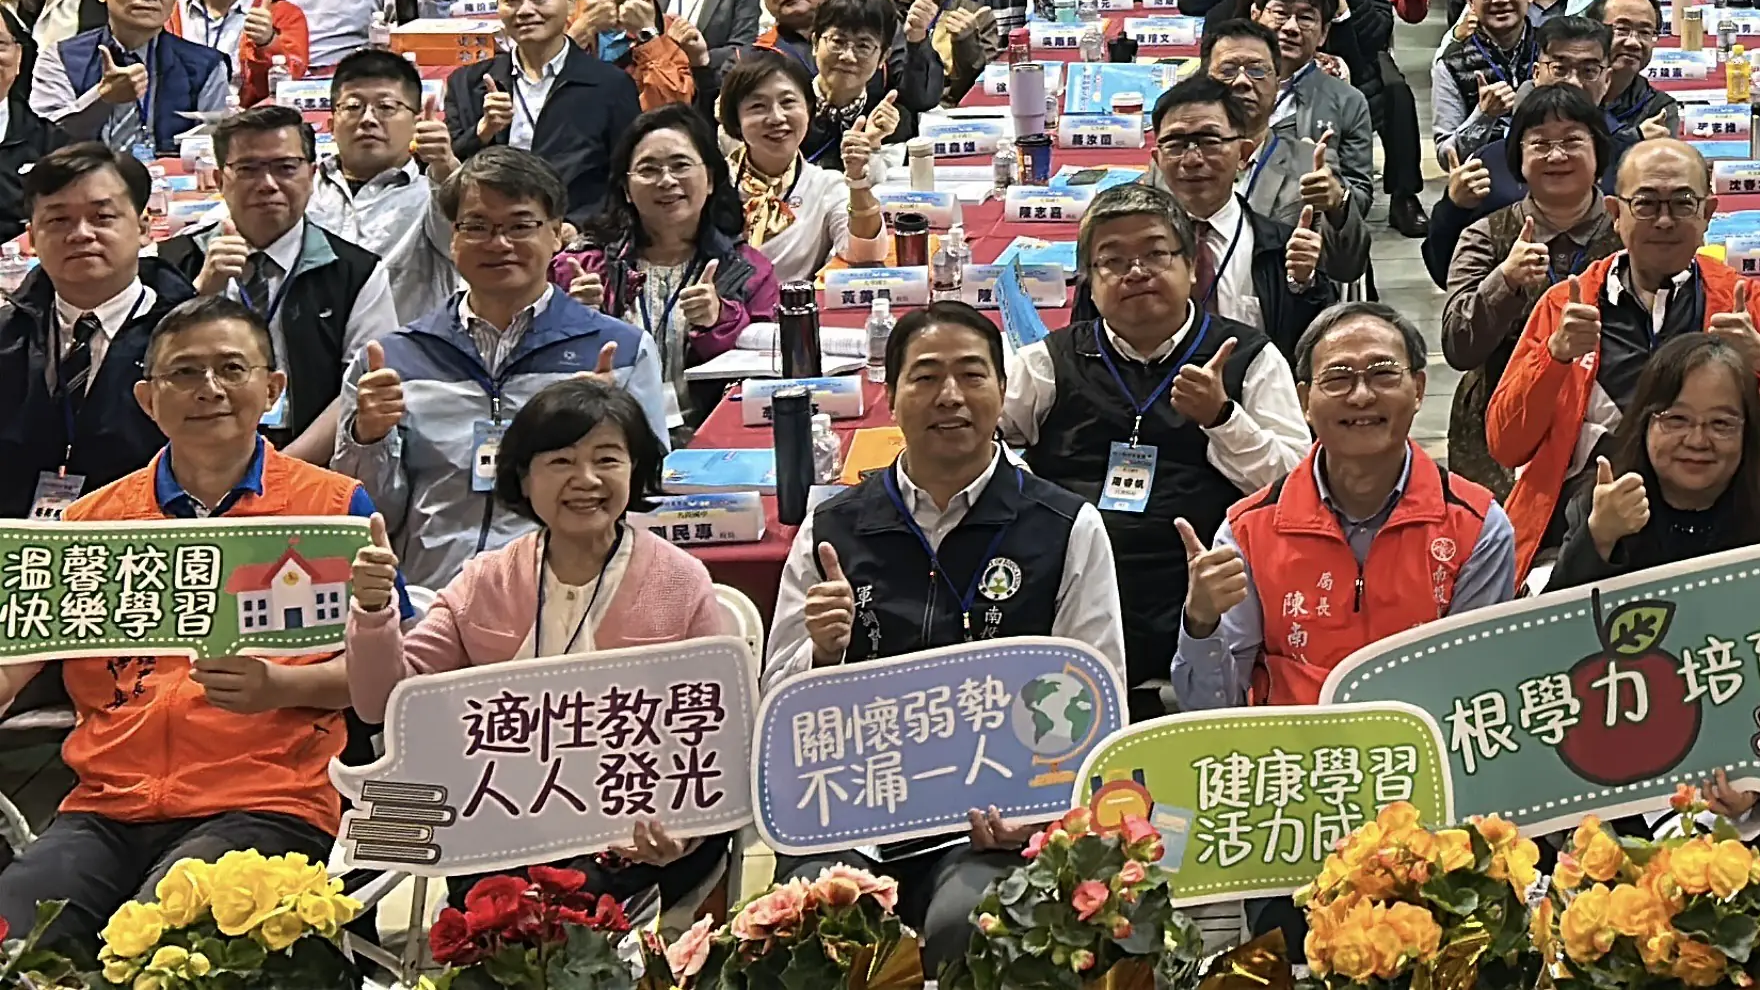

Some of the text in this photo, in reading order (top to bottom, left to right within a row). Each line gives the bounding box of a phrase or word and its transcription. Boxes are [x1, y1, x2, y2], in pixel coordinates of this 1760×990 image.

[3, 544, 221, 590] 溫馨校園
[0, 589, 218, 639] 快樂學習
[461, 680, 726, 763] 適性教學
[790, 676, 1011, 767] 關懷弱勢
[461, 748, 726, 820] 人人發光
[796, 734, 1014, 827] 不漏一人
[1190, 745, 1419, 812] 健康學習
[1195, 806, 1400, 869] 活力成
